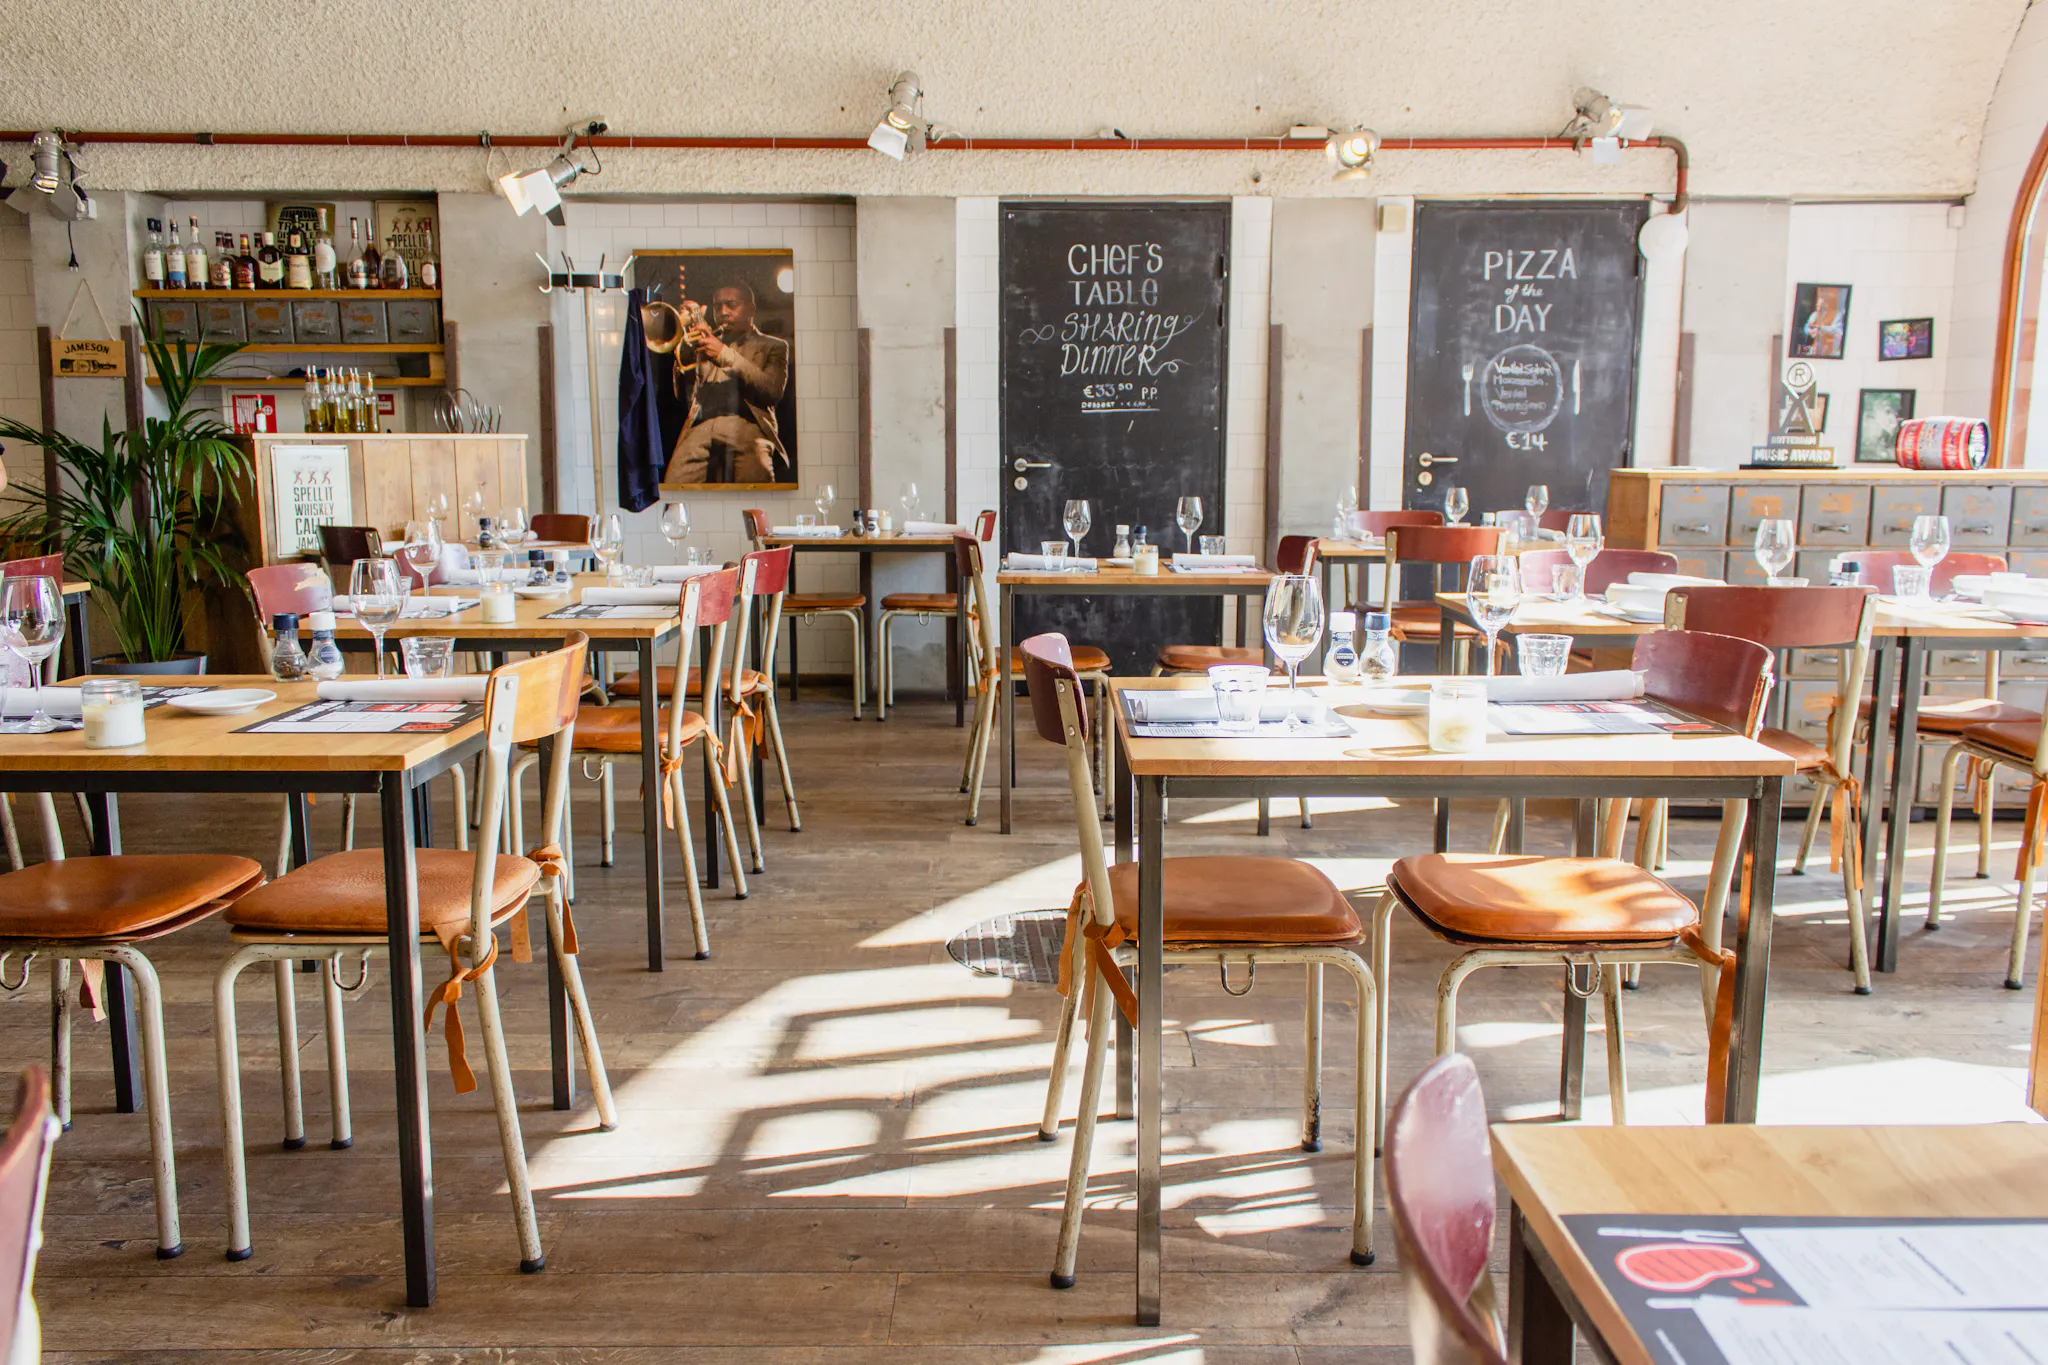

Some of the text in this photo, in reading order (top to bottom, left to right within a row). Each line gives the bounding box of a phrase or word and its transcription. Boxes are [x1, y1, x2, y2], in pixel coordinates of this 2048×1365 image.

[279, 221, 320, 231] TRPLE
[1504, 283, 1544, 303] of the
[1495, 304, 1553, 333] DAY
[64, 343, 110, 354] JAMESON
[1505, 432, 1548, 452] €14
[1753, 448, 1831, 463] MUSIC AWARD
[293, 487, 333, 501] SPELL IT
[295, 503, 334, 516] WHISKEY
[295, 536, 321, 550] JAME
